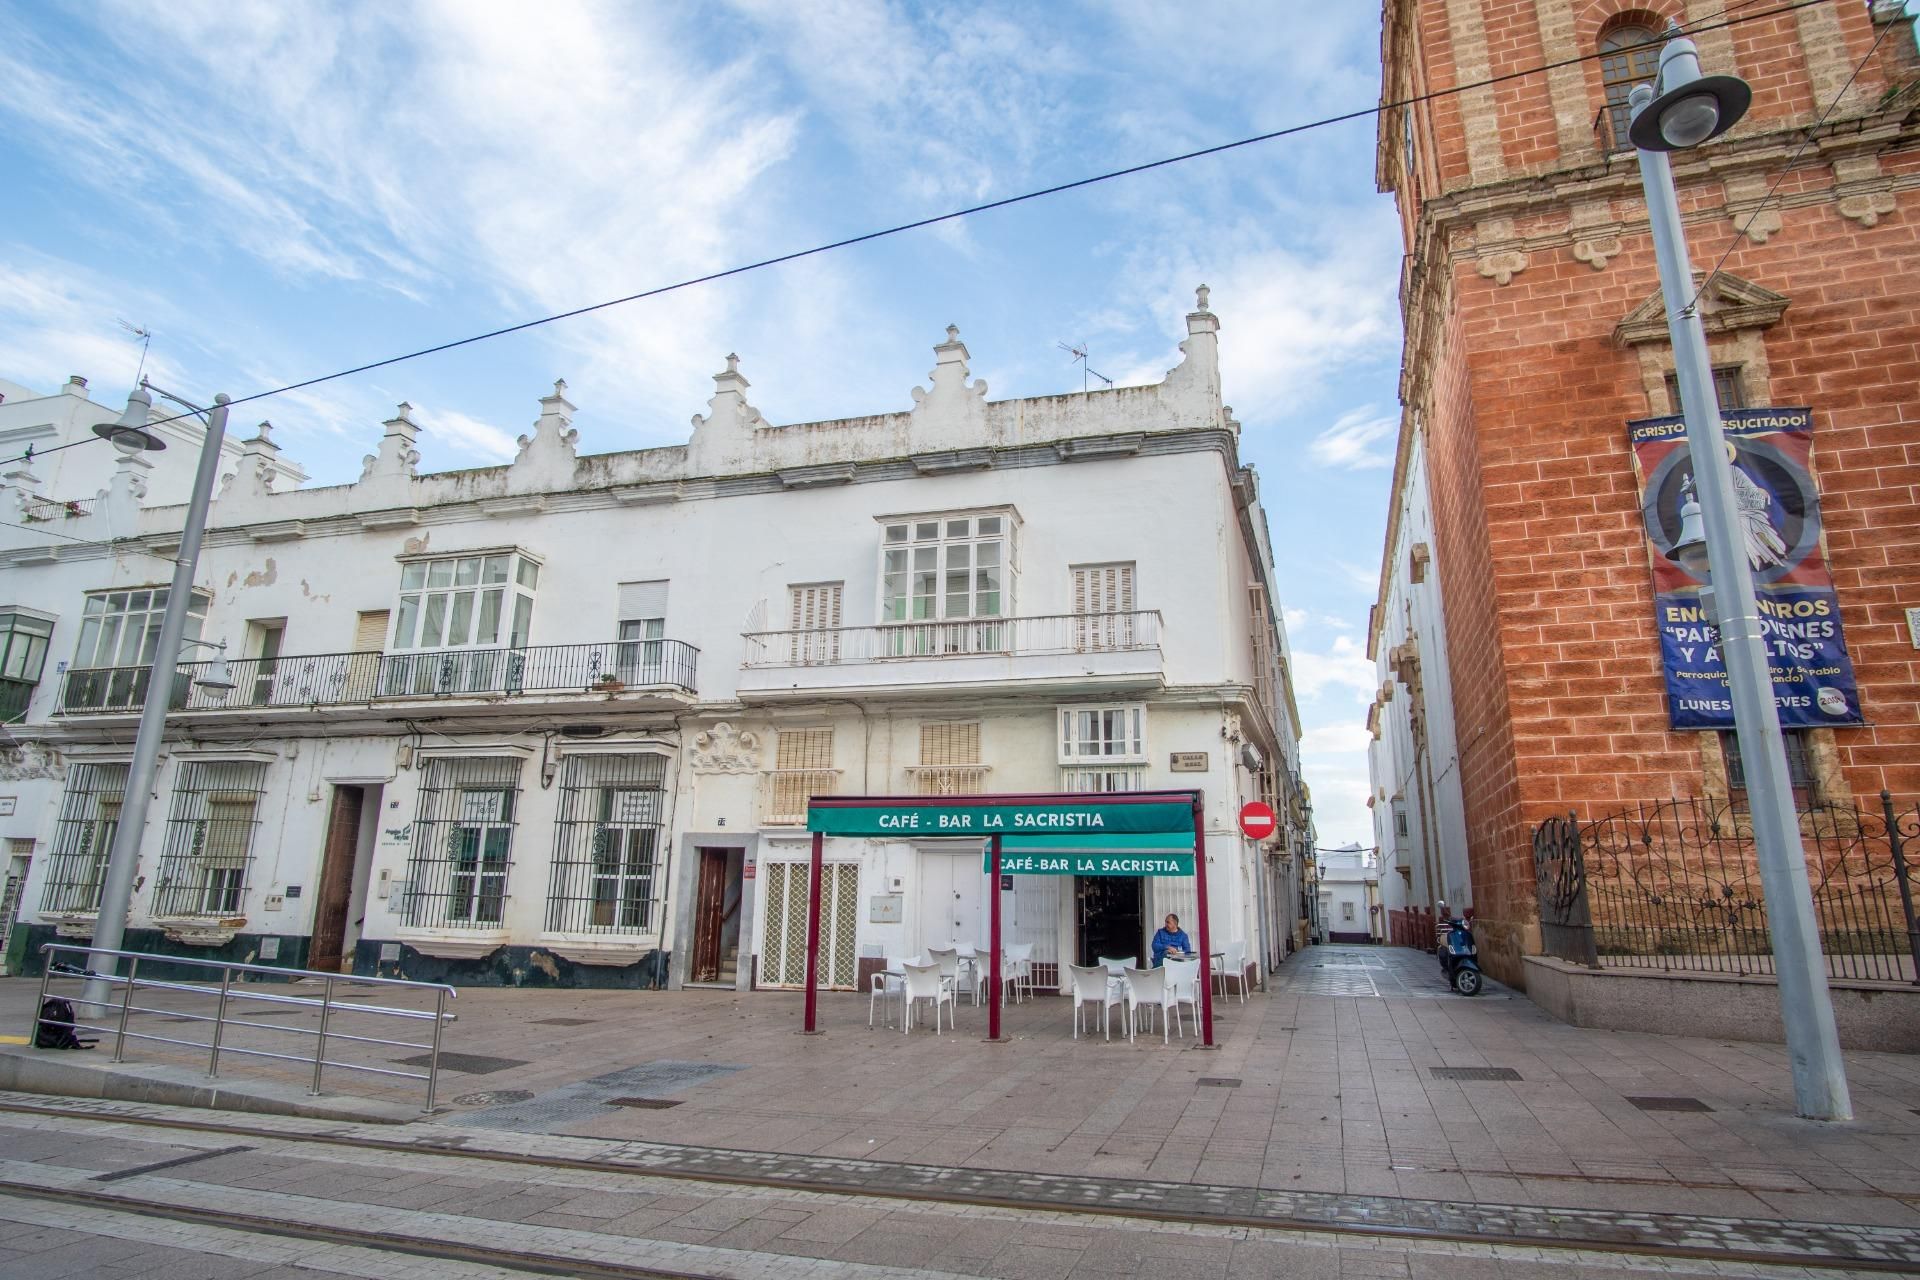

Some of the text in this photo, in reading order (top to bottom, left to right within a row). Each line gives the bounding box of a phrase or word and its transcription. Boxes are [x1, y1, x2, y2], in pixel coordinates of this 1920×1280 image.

[1633, 415, 1806, 441] ¡CRISTO ESUCITADO!
[1680, 647, 1695, 663] Y
[1676, 670, 1727, 683] Parroquia
[1786, 667, 1794, 675] y
[1807, 667, 1841, 676] Pablo
[1679, 699, 1731, 711] LUNES
[1775, 696, 1811, 707] EVES
[879, 813, 919, 828] CAFÉ
[939, 814, 972, 827] BAR
[983, 814, 1004, 827] LA
[1014, 812, 1104, 827] SACRISTIA
[1077, 859, 1095, 871] LA
[1101, 859, 1180, 872] SACRISTIA
